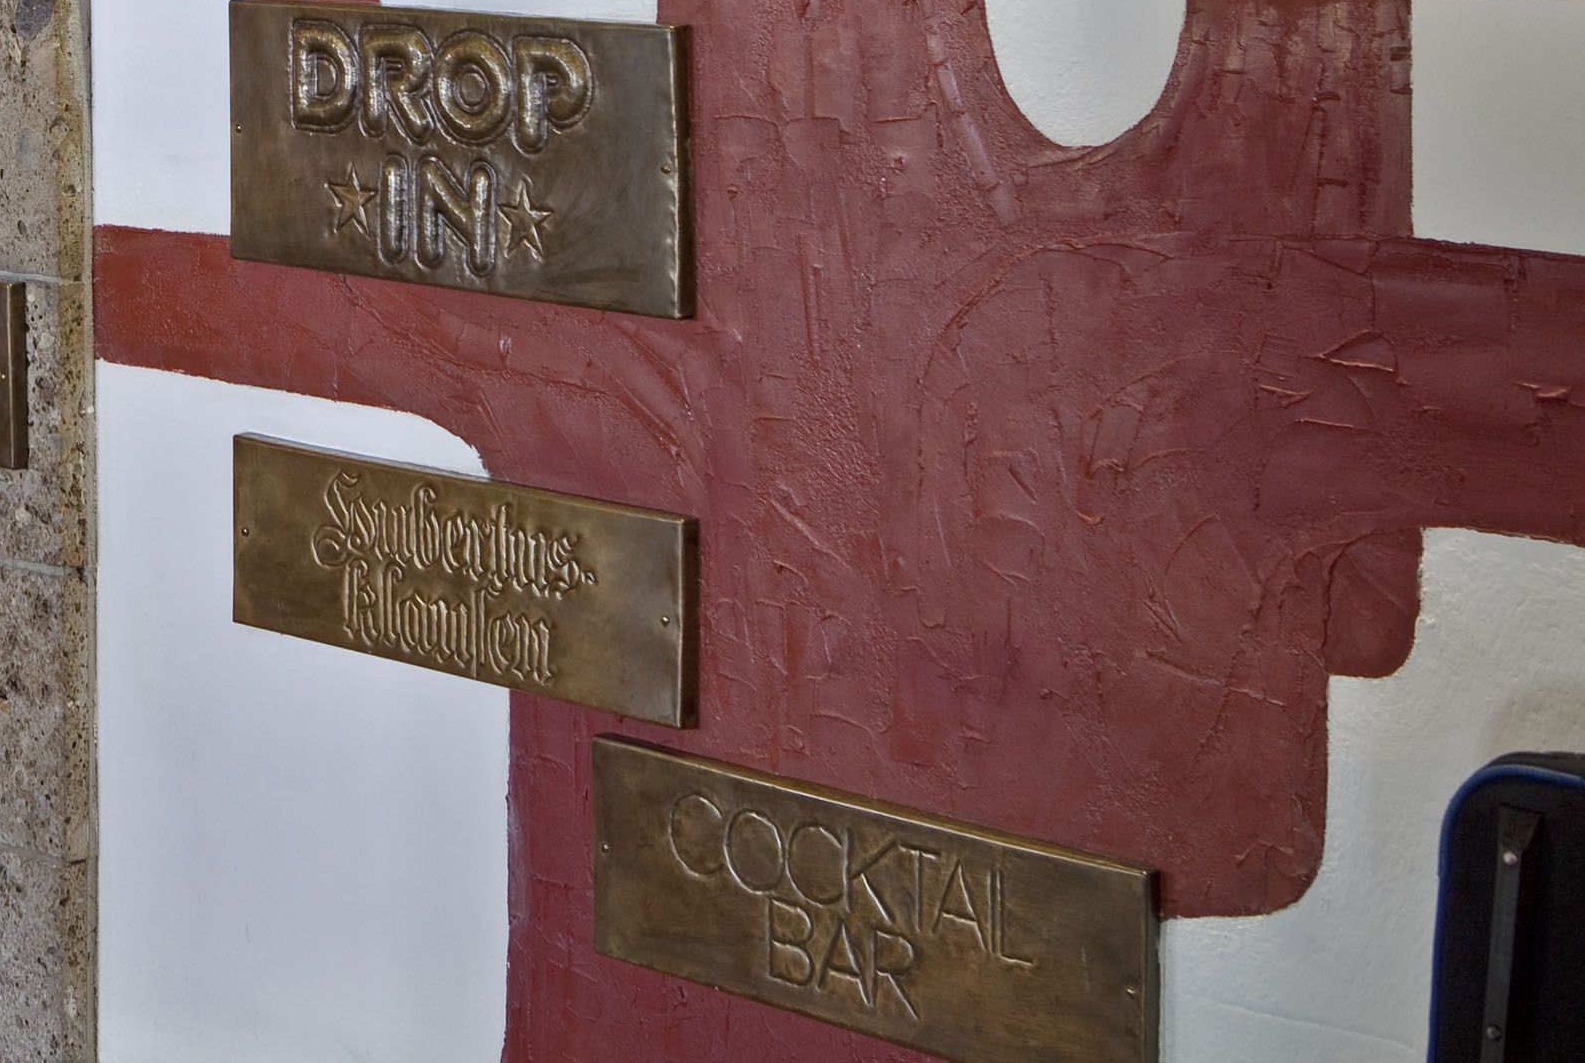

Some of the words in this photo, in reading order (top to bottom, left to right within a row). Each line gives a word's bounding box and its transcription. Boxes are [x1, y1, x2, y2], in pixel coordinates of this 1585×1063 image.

[288, 16, 596, 155] DROP
[375, 151, 498, 278] IN
[668, 792, 1035, 968] COCKTAIL
[765, 897, 921, 1022] BAR
